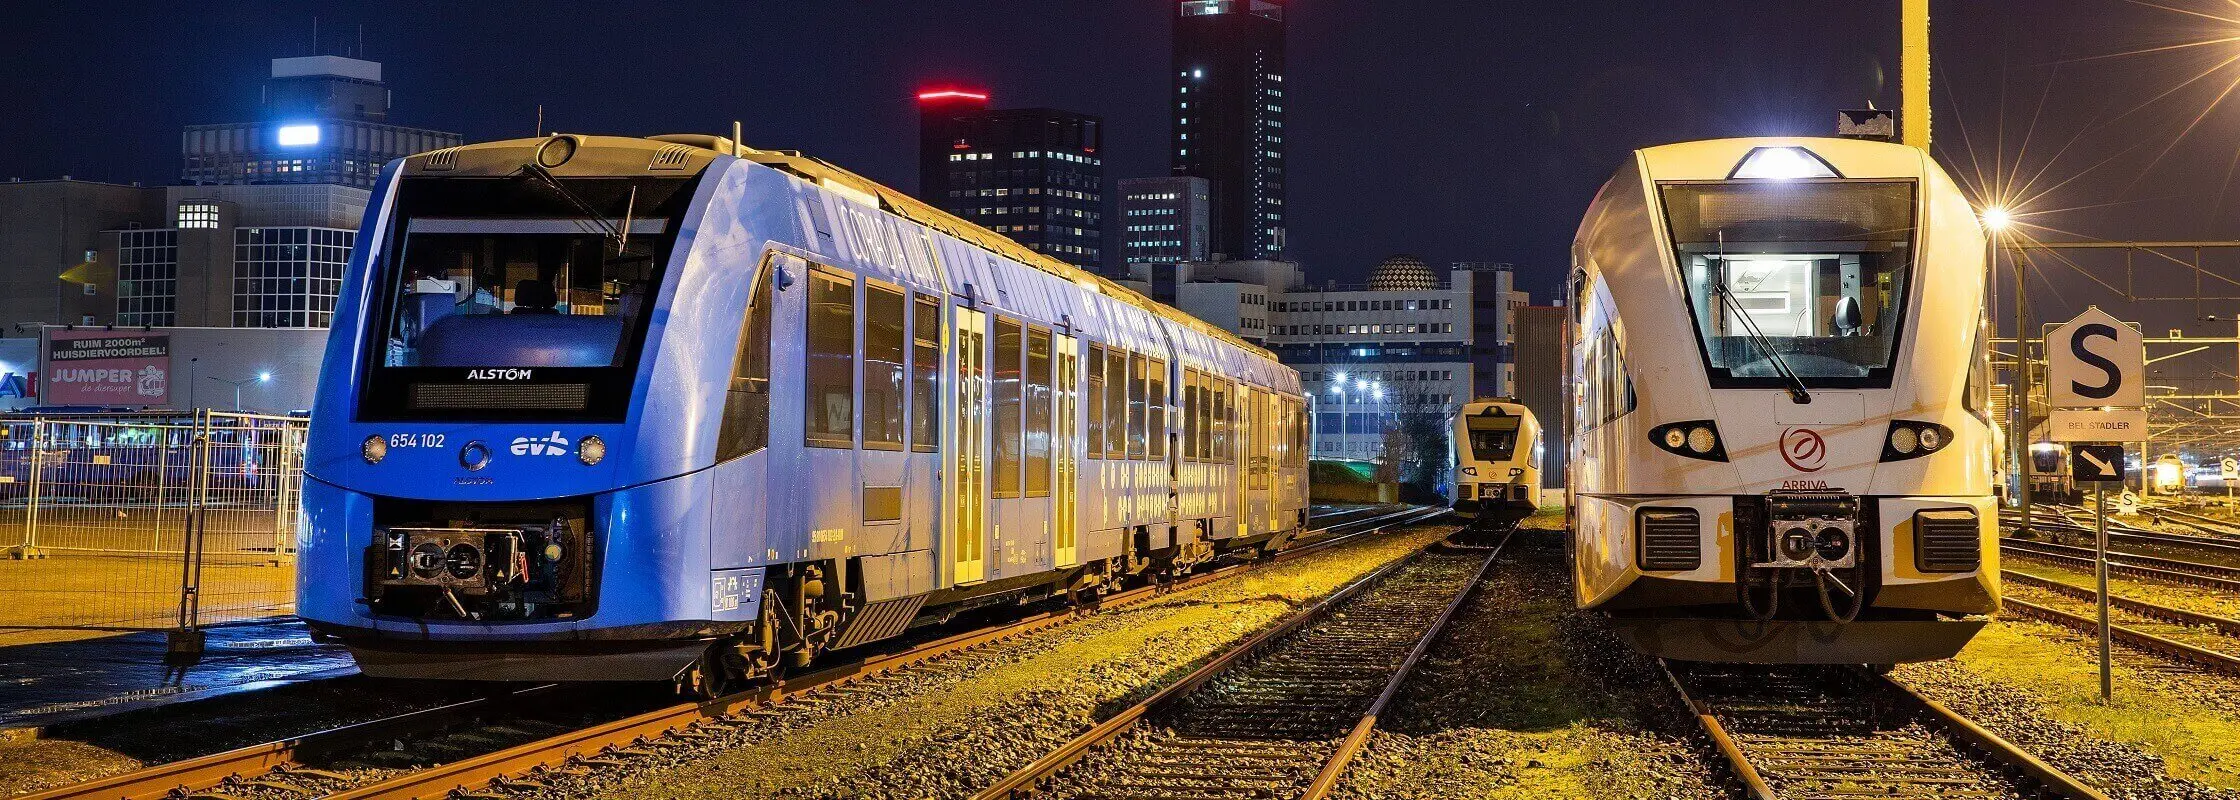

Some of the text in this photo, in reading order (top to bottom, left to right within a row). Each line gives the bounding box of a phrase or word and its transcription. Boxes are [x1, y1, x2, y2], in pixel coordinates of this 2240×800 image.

[73, 339, 102, 349] RUIM
[53, 346, 165, 359] HUISDIERVOORDEEL!
[2070, 323, 2122, 400] S
[52, 369, 132, 383] JUMPER
[467, 368, 532, 381] ALSTOM
[80, 383, 132, 395] de diersuper
[2068, 421, 2130, 430] BEL STADLER
[390, 434, 445, 448] 654 102
[510, 430, 569, 456] evb
[2225, 460, 2234, 473] S
[1782, 480, 1828, 490] ARRIVA
[2123, 494, 2133, 507] S
